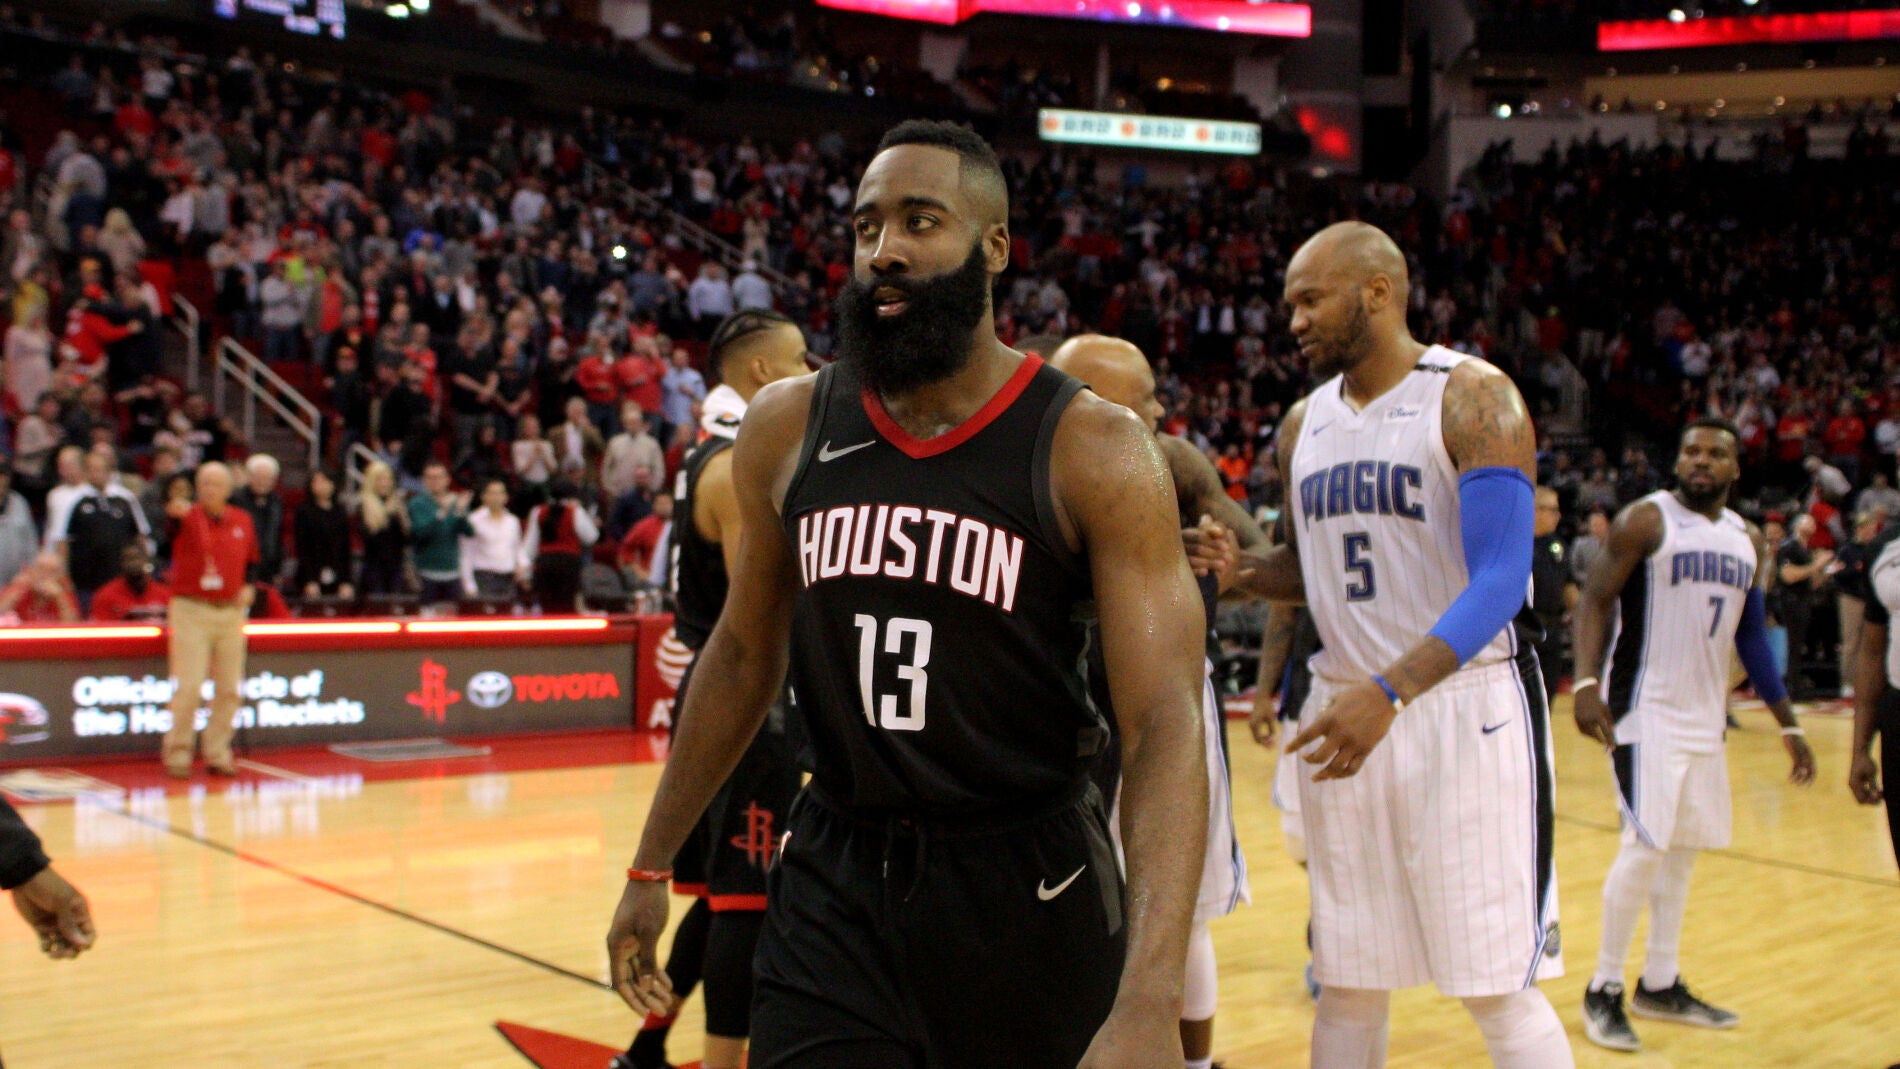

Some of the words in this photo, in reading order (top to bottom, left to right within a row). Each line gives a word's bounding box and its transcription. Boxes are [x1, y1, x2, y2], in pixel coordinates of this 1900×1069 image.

[1300, 460, 1426, 532] MAGIC
[799, 504, 1024, 613] HOUSTON
[1343, 531, 1376, 600] 5
[1709, 596, 1725, 638] 7
[291, 669, 324, 698] of
[511, 672, 620, 703] TOYOTA
[854, 613, 933, 731] 13
[73, 707, 128, 736] the
[257, 698, 365, 727] Rockets
